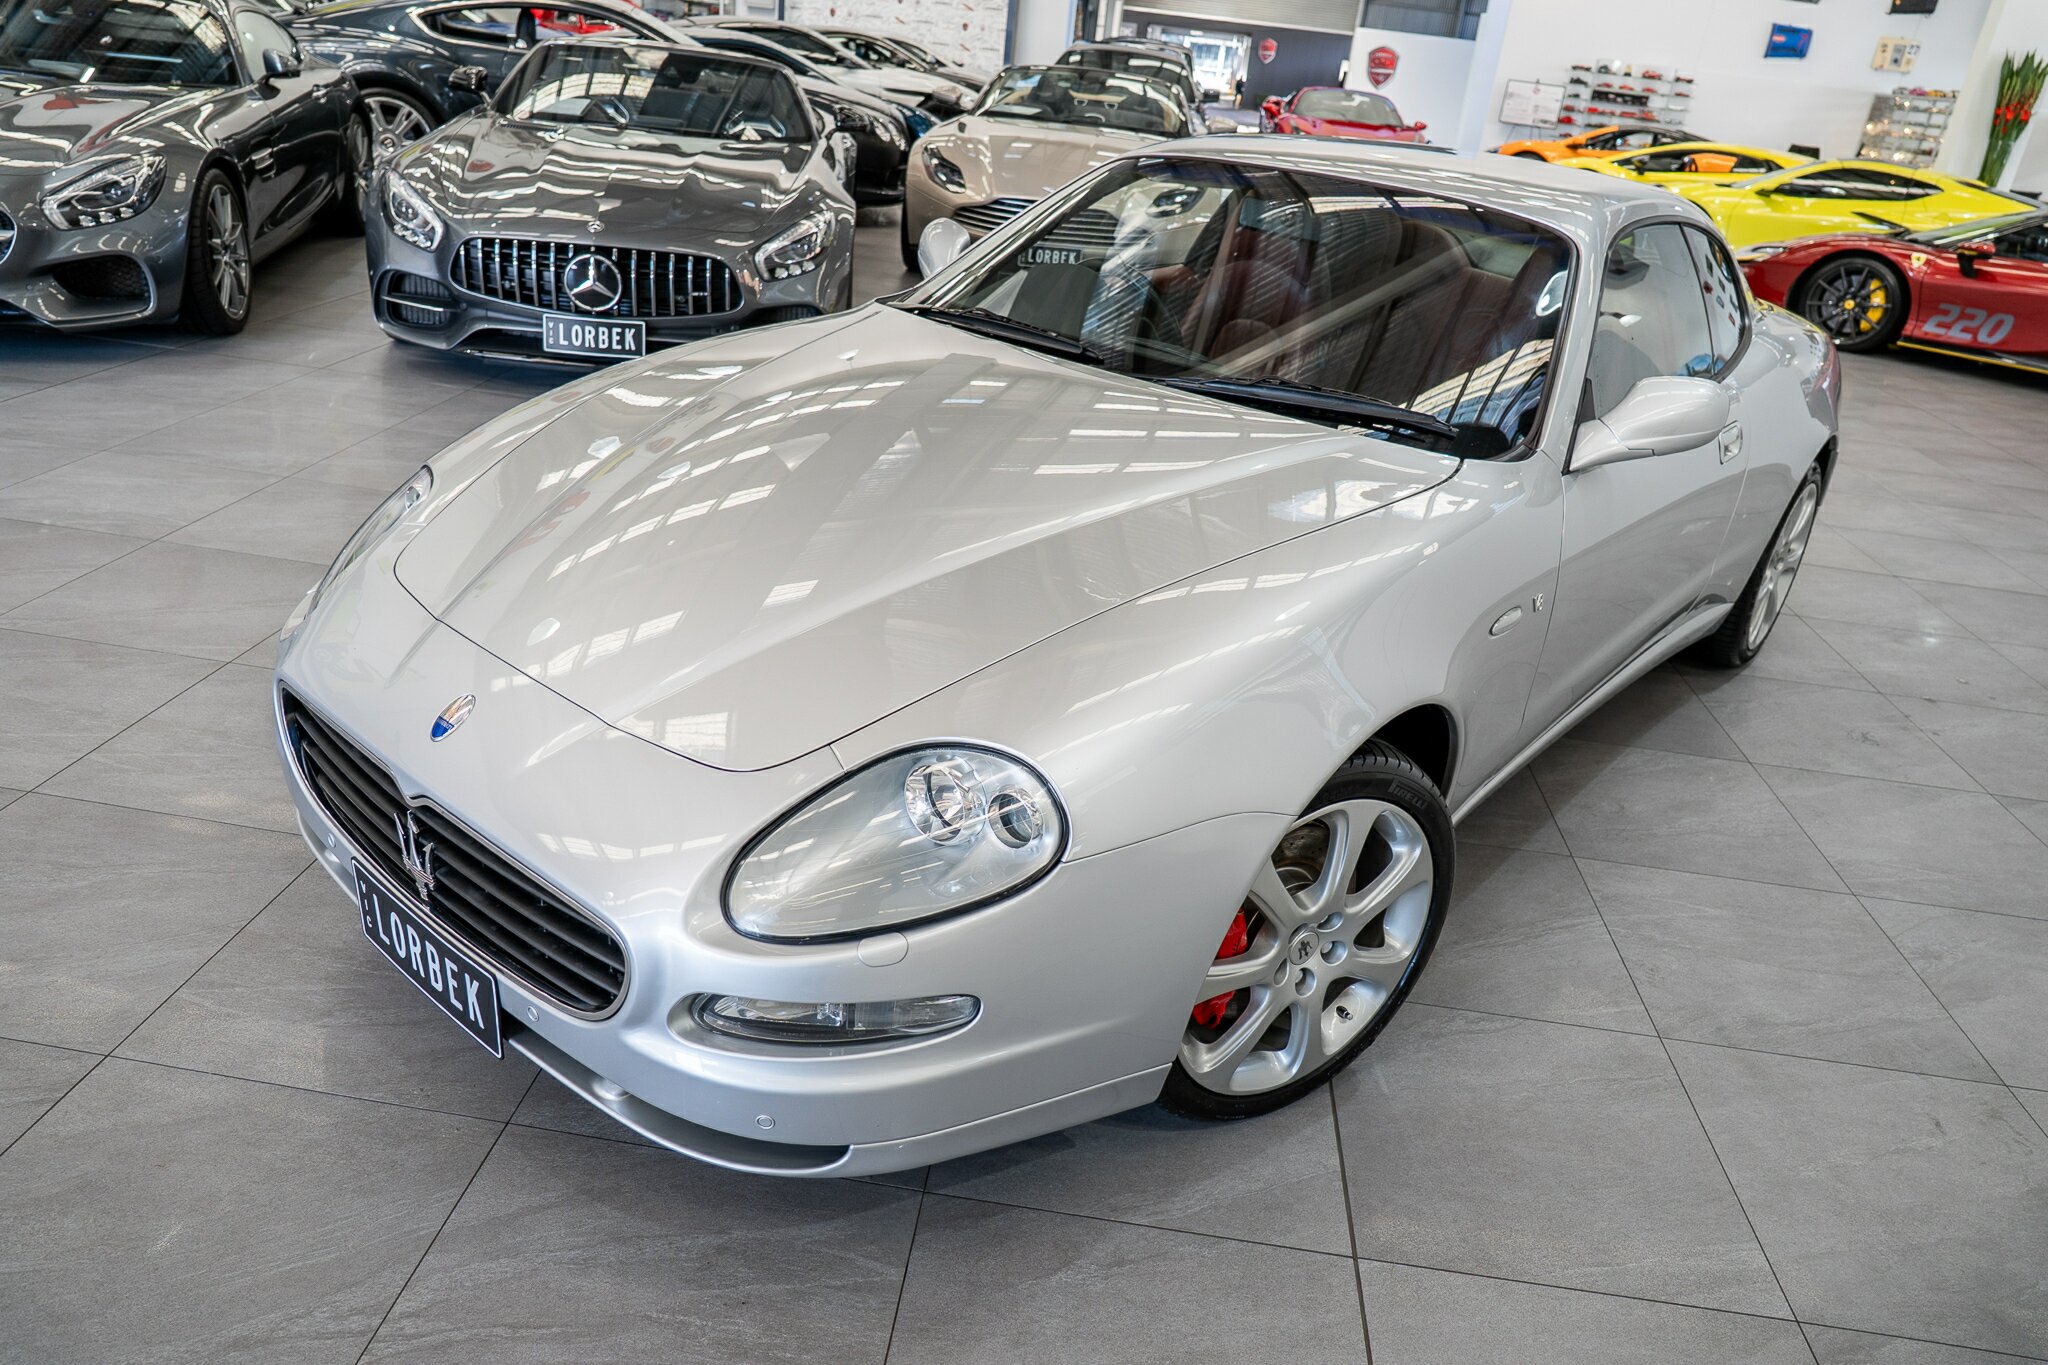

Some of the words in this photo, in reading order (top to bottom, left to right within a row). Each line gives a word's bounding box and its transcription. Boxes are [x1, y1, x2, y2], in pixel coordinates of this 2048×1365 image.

[1027, 247, 1077, 265] LORBEK
[558, 322, 636, 351] LORBEK
[1922, 303, 2015, 345] 220
[1387, 777, 1429, 809] PIRELLI
[359, 880, 373, 928] VIC
[372, 893, 485, 1030] LORBEK
